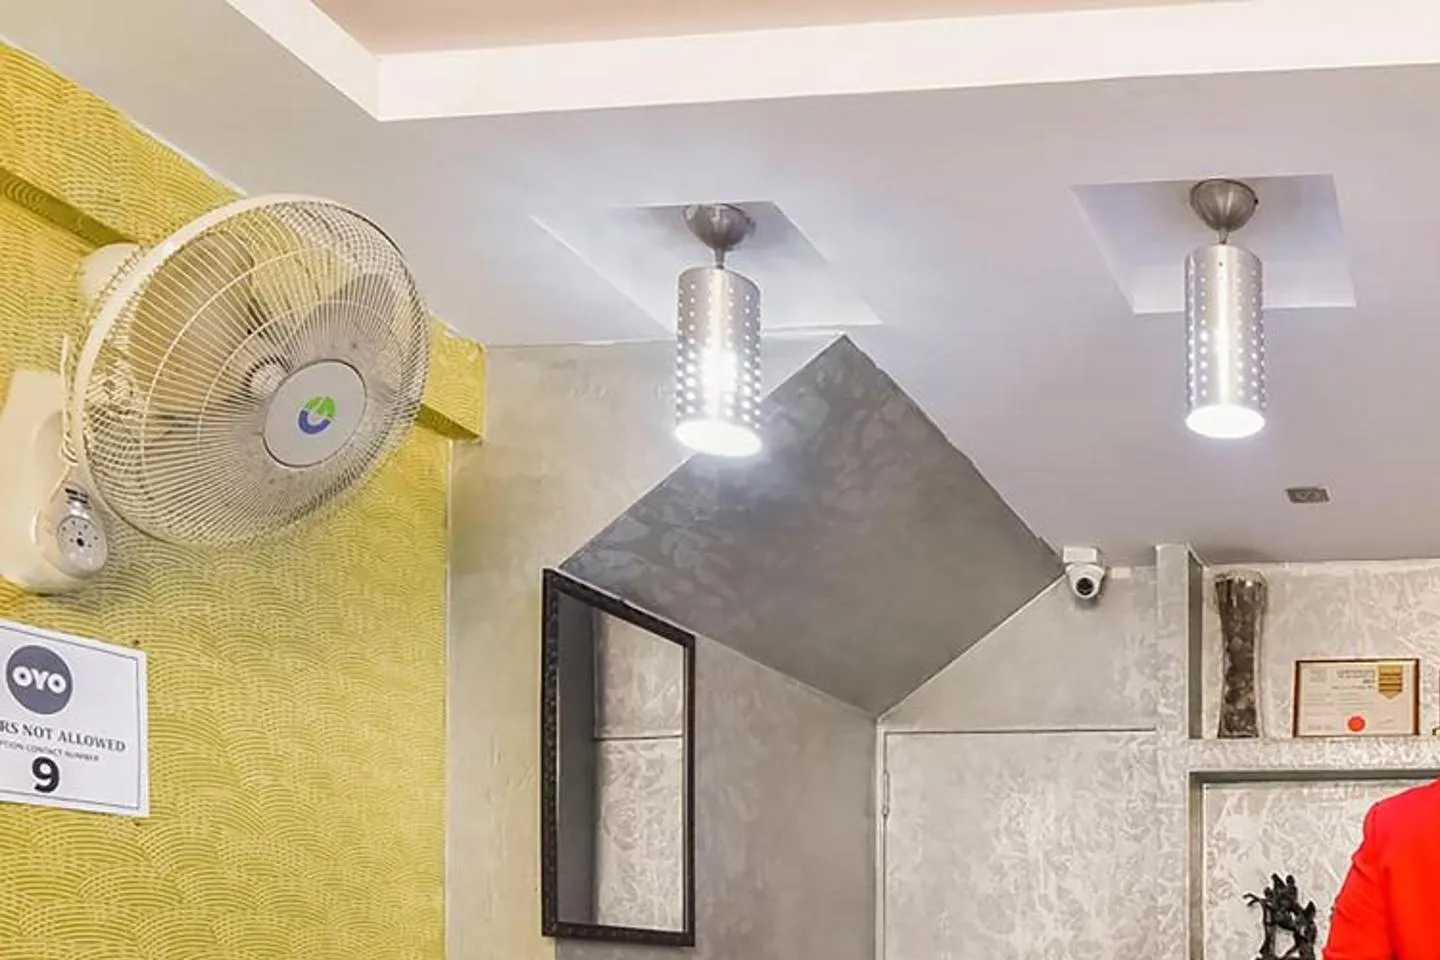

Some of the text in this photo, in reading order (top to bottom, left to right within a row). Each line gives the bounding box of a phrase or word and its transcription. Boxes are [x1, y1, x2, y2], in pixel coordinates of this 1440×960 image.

[12, 665, 67, 694] OYO
[22, 723, 53, 740] NOT
[58, 730, 126, 752] ALLOWED
[32, 756, 60, 793] 9
